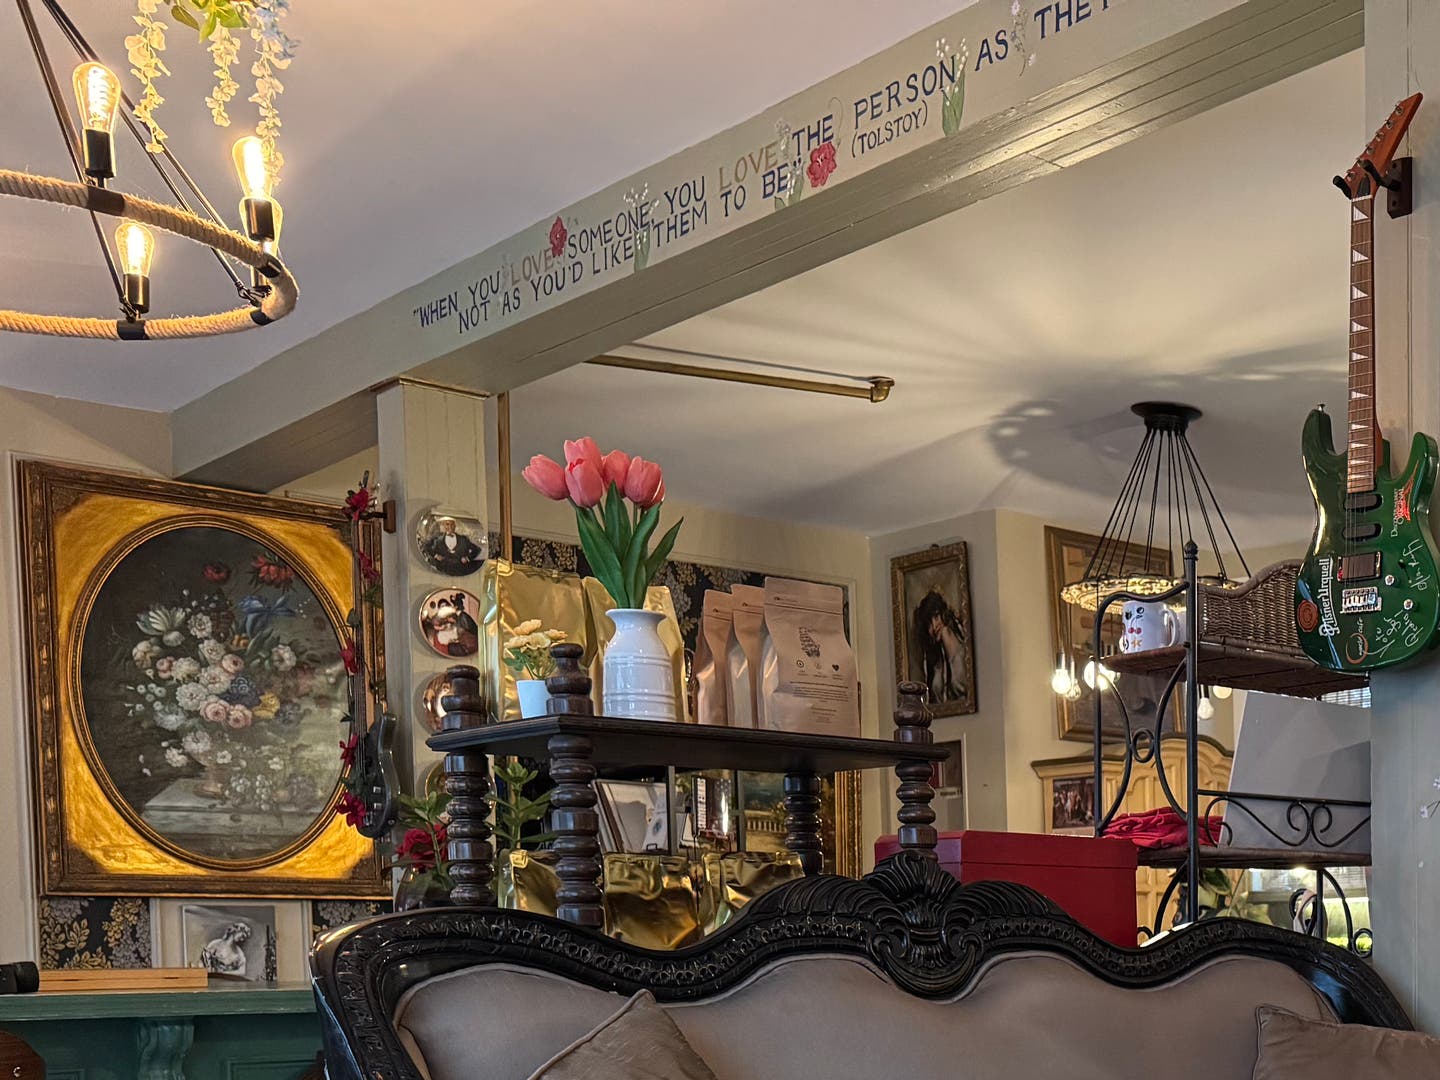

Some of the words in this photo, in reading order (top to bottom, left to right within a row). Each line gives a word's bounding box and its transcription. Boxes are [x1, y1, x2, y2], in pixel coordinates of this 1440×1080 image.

[851, 99, 929, 158] (TOLSTOY)
[413, 292, 459, 328] "WHEN
[468, 270, 501, 305] YOU
[510, 247, 556, 286] LOVE
[664, 175, 705, 215] YOU
[719, 143, 779, 193] LOVE
[792, 114, 834, 156] THE
[854, 54, 956, 130] PERSON
[974, 29, 1009, 71] AS
[458, 300, 490, 334] NOT
[501, 287, 521, 316] AS
[530, 261, 584, 302] YOU'D
[592, 236, 634, 275] LIKE
[653, 200, 708, 248] THEM
[720, 184, 747, 218] TO
[1317, 557, 1332, 599] Urquell
[1318, 597, 1341, 637] Pilsner
